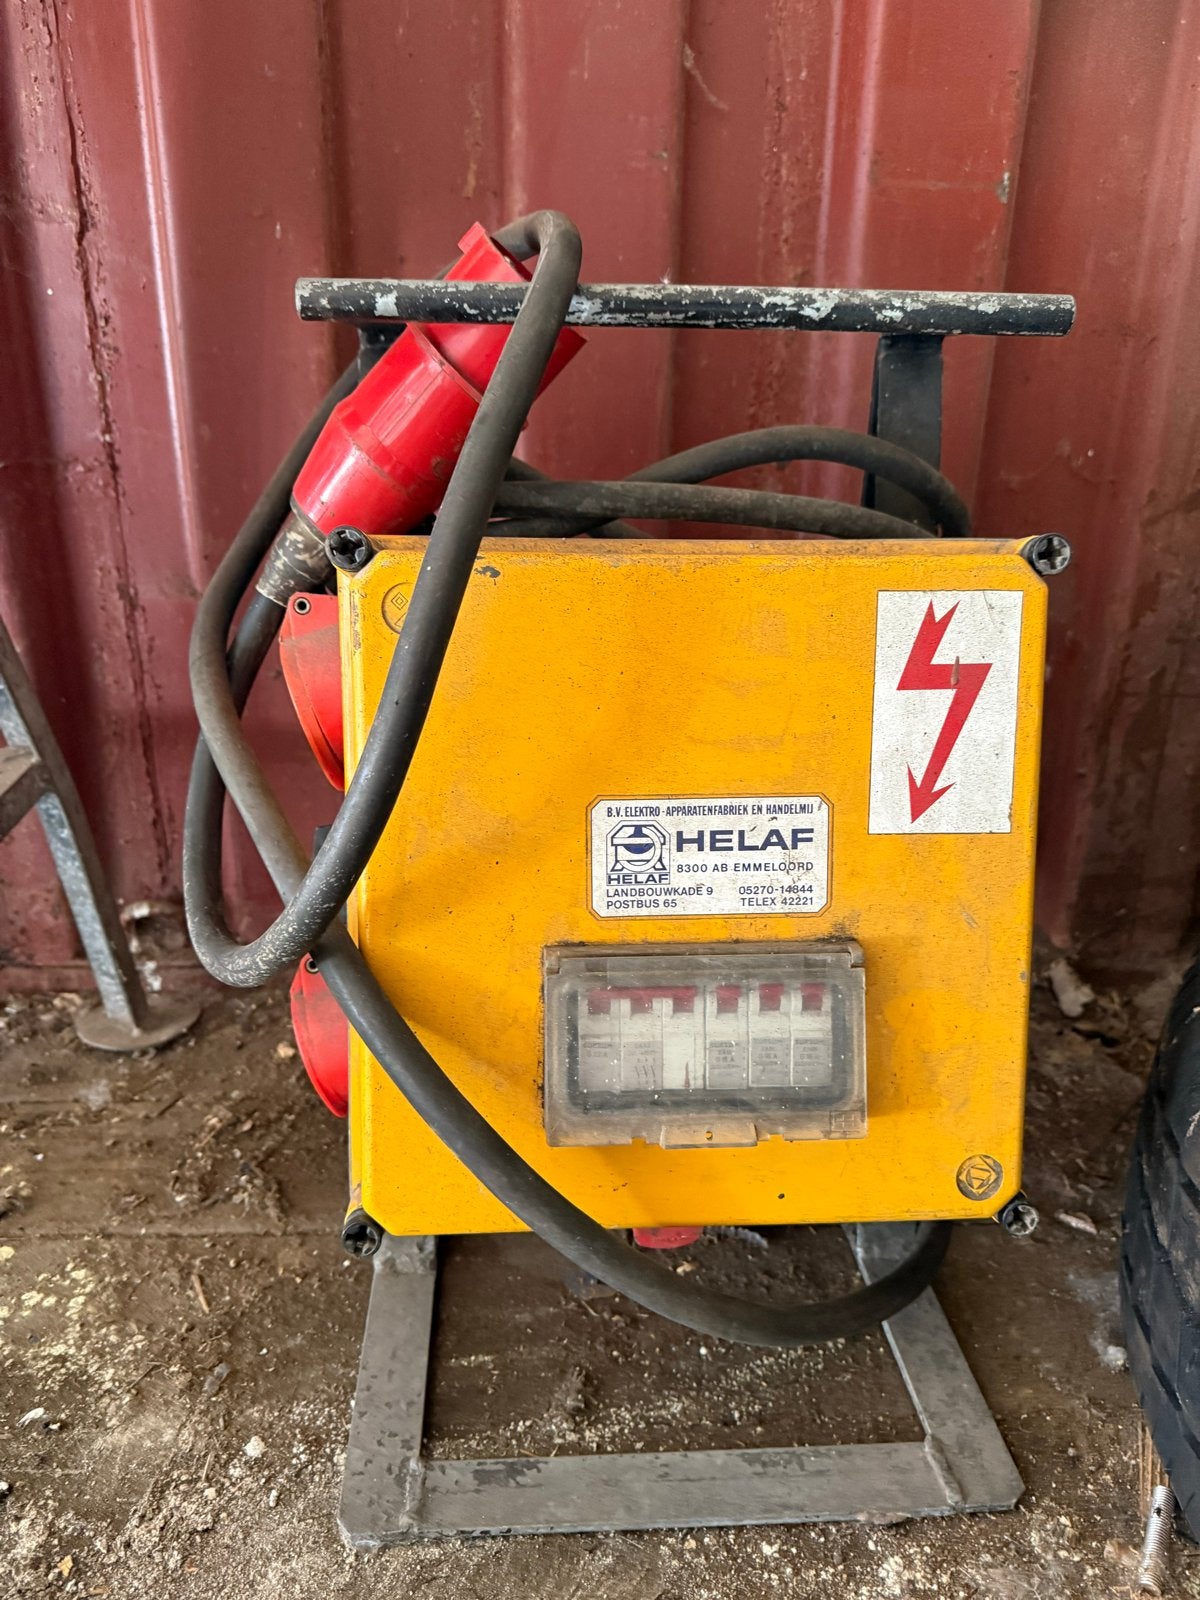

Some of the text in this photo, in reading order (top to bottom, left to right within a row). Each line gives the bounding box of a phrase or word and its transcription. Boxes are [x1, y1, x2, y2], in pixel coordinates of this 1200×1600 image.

[752, 804, 763, 815] EN
[766, 803, 814, 815] HANDELMIJ
[676, 828, 814, 852] HELAF
[677, 861, 814, 873] 8300 AB EMMELOORD
[607, 873, 669, 885] HELAF
[606, 886, 714, 898] LANDBOUWKADE 9
[738, 884, 814, 895] 05270-14844
[606, 898, 678, 910] POSTBUS 65
[741, 896, 814, 907] TELEX 42221
